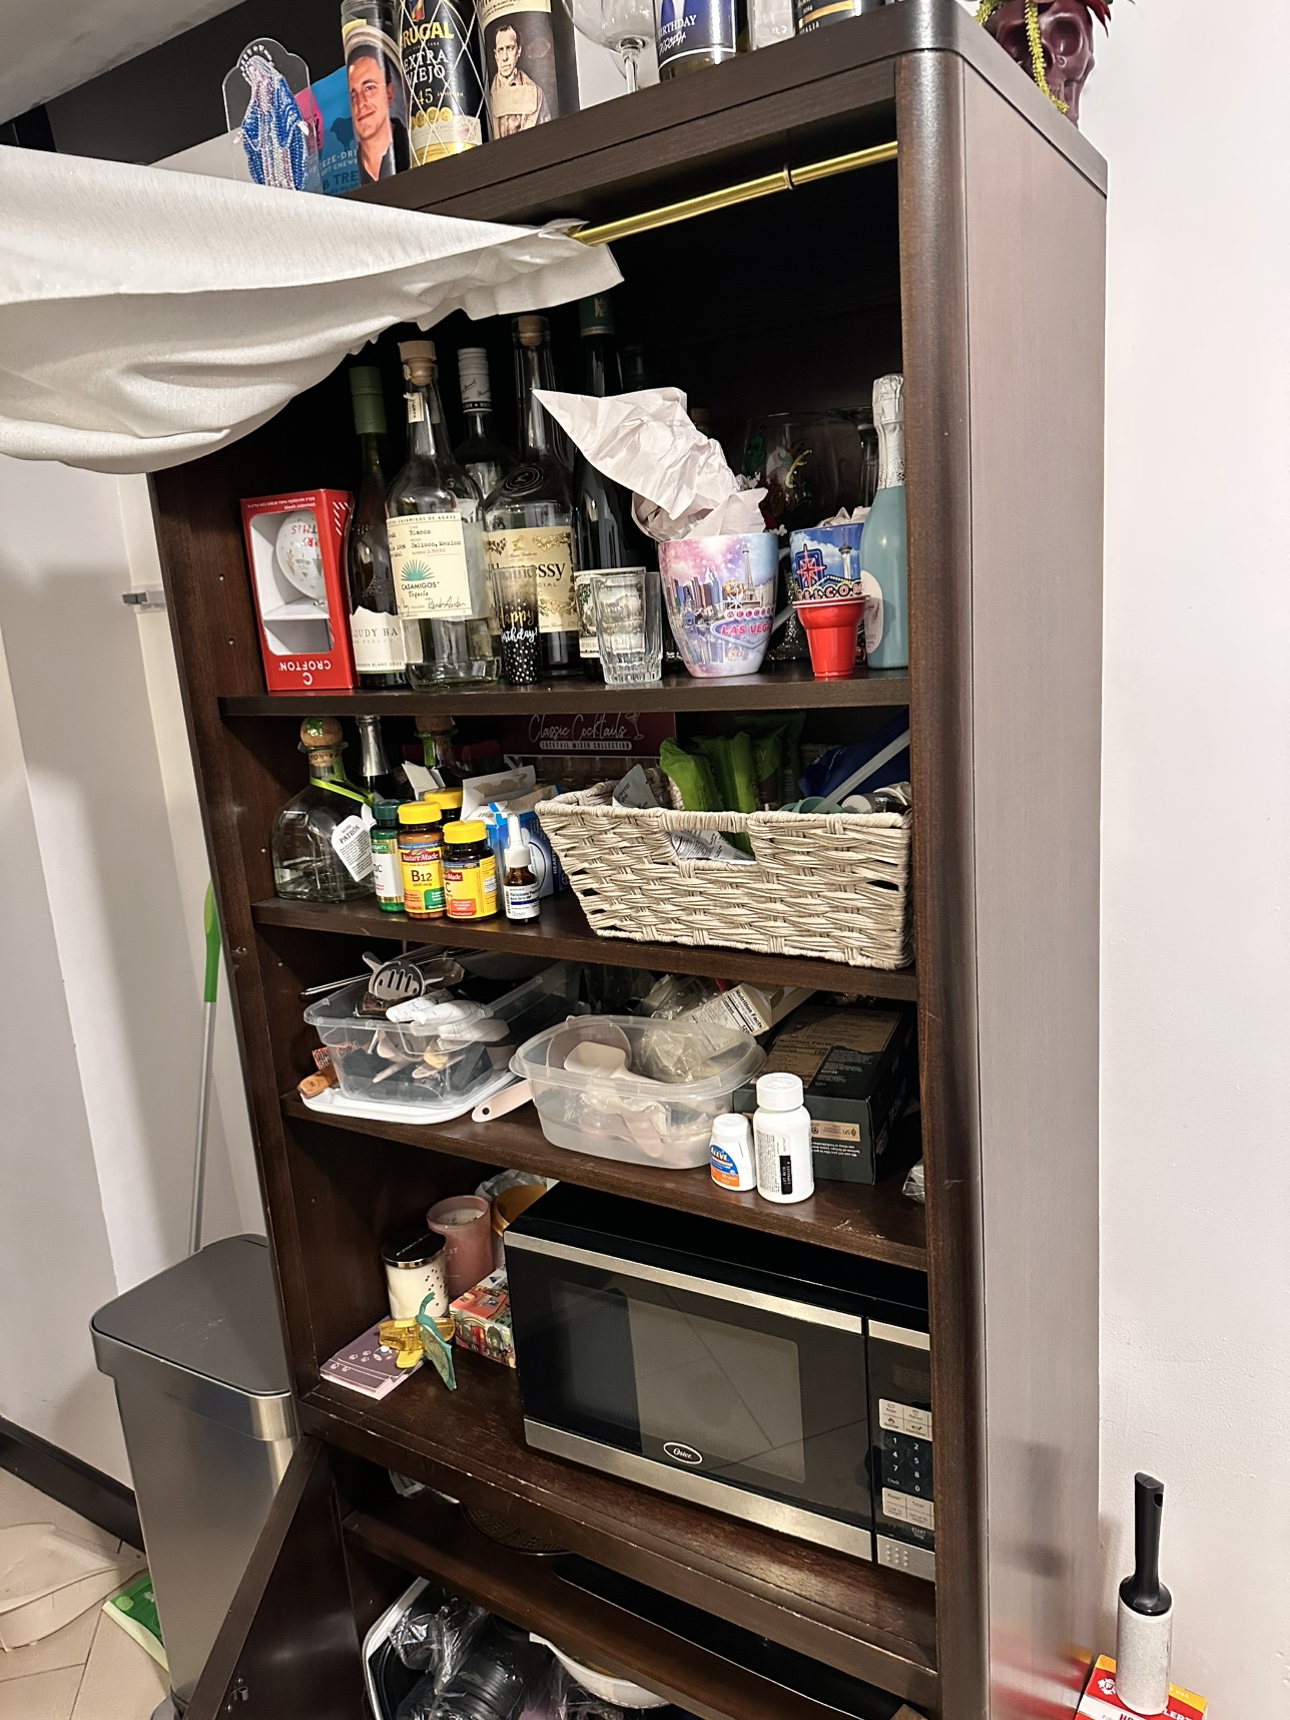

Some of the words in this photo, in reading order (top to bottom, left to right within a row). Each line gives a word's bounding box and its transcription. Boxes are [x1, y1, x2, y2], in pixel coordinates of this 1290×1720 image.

[404, 48, 449, 72] EXTRA
[721, 624, 746, 636] LAS
[279, 660, 331, 672] CROFTON
[302, 673, 313, 686] C
[528, 713, 571, 743] Classic
[572, 712, 628, 741] Cocktails
[541, 741, 570, 749] COCKTAIL
[572, 741, 591, 749] MIXER
[593, 741, 630, 749] COLLECTION
[411, 870, 433, 882] B12
[735, 989, 753, 1014] Nutrition
[751, 1011, 763, 1029] Facts
[914, 1442, 919, 1450] 2
[673, 1447, 692, 1460] Oster
[915, 1484, 920, 1492] 0
